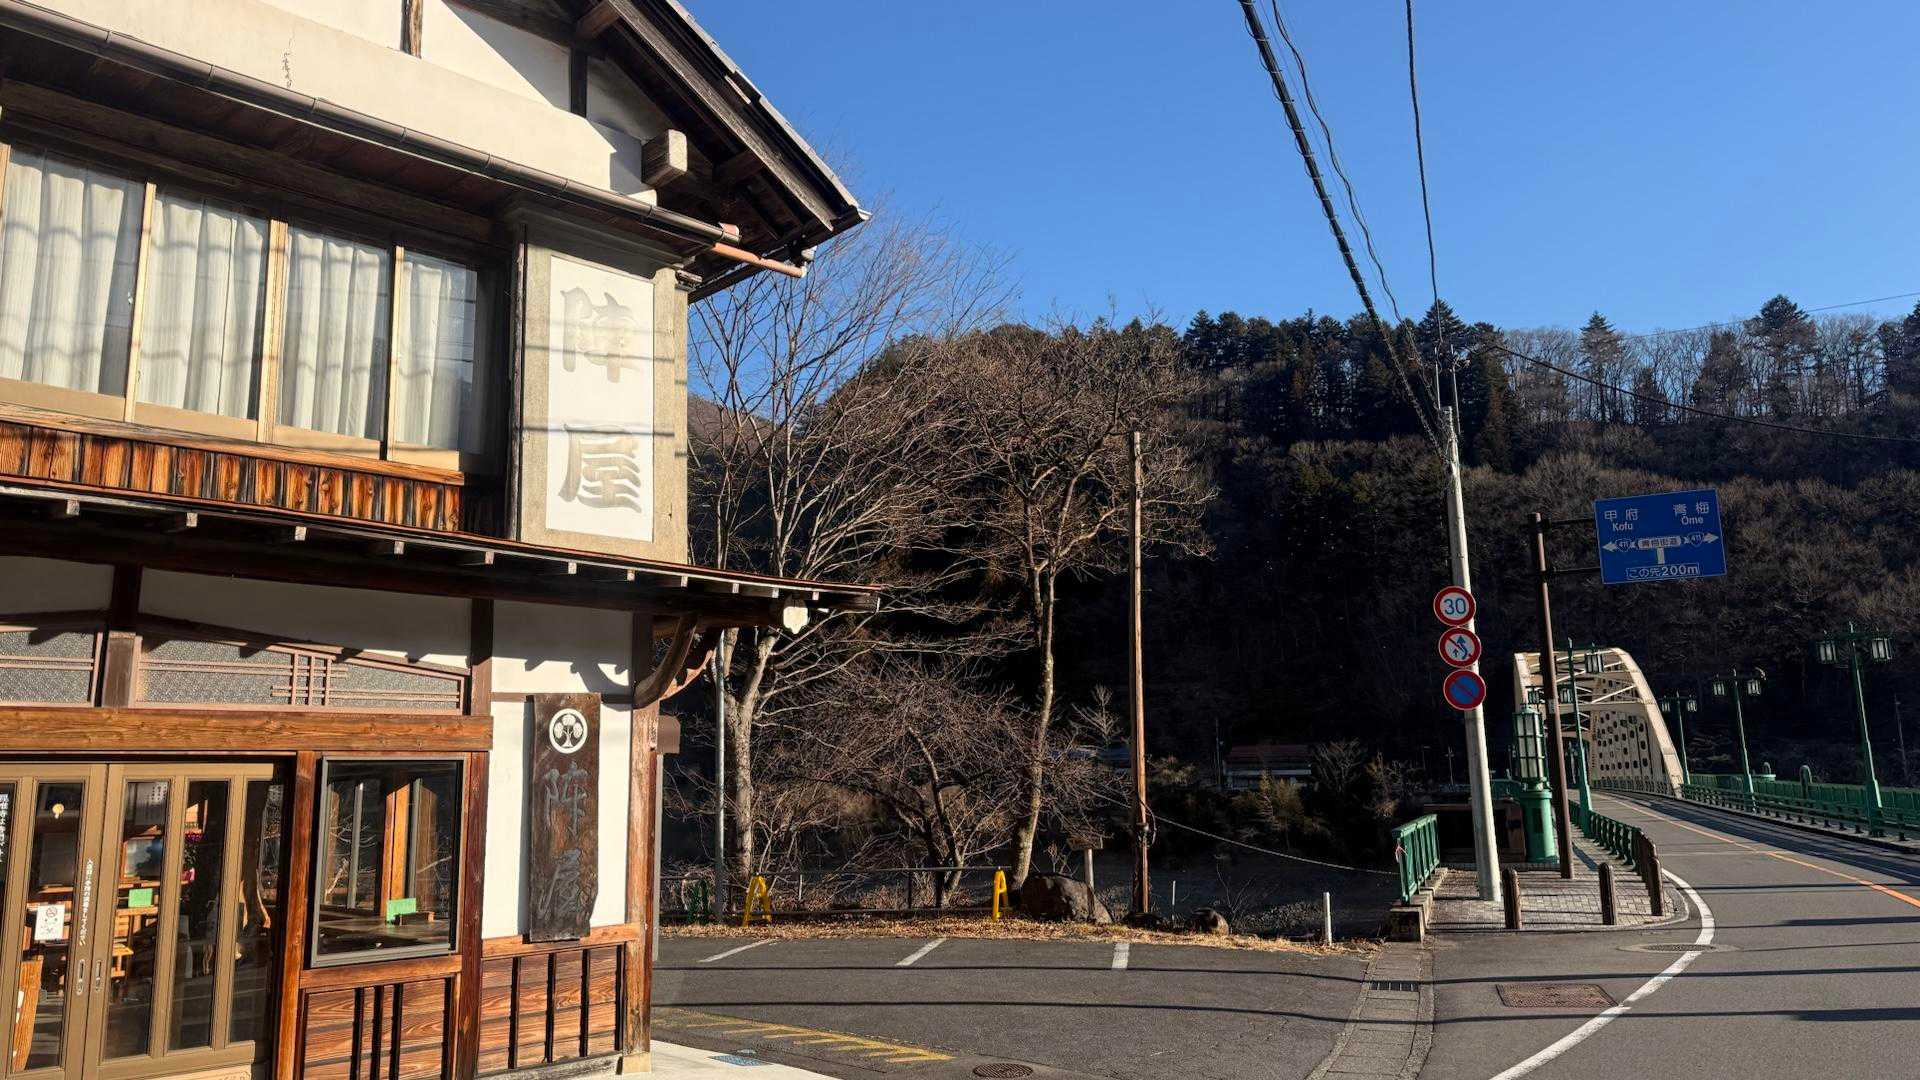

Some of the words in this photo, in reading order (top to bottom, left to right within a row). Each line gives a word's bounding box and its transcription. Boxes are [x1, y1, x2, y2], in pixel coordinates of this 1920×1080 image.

[1604, 508, 1638, 521] 甲府
[1612, 521, 1633, 531] Kofu
[1443, 598, 1467, 615] 30
